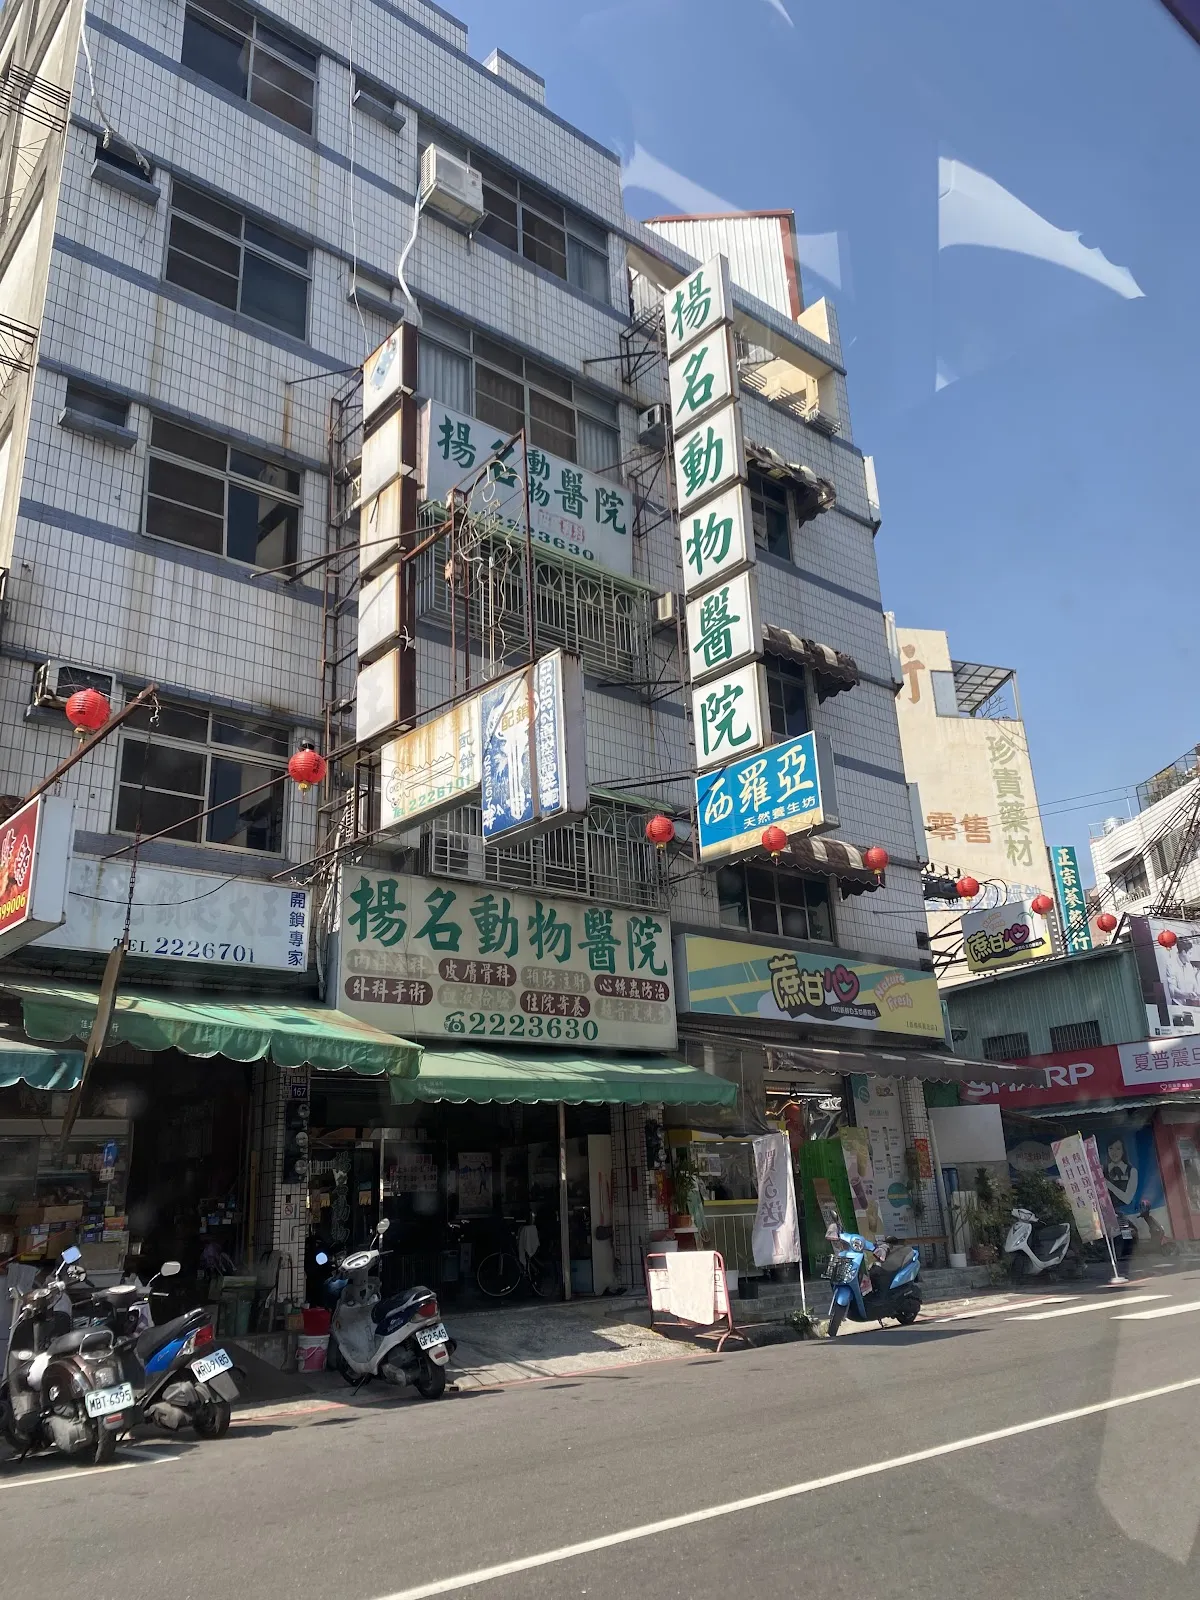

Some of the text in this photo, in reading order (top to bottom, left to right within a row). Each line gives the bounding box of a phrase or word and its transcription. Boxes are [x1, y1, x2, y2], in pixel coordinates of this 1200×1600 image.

[671, 271, 752, 755] 揚名動物醫院
[409, 775, 472, 810] 2226701
[705, 744, 814, 825] 西羅亞
[744, 796, 816, 829] 天然養生坊
[985, 735, 1032, 867] 珍貴藥材
[927, 811, 991, 844] 零售
[288, 891, 306, 966] 開鎖專家
[347, 876, 668, 976] 揚名動物醫院
[155, 937, 255, 964] 2226701
[967, 922, 1030, 963] 蔗甘心
[445, 961, 511, 985] 皮膚骨科
[527, 968, 586, 992] 預防注射
[768, 953, 860, 1012] 蔗甘心
[874, 973, 905, 1001] Nature
[352, 979, 426, 1004] 外科手術
[599, 975, 666, 1001] 心絲蟲防治
[886, 993, 914, 1012] Fresh
[526, 993, 585, 1018] 住院寄養
[469, 1012, 599, 1041] 2223630
[293, 1087, 306, 1097] 167
[89, 1389, 132, 1412] MBT-6395
